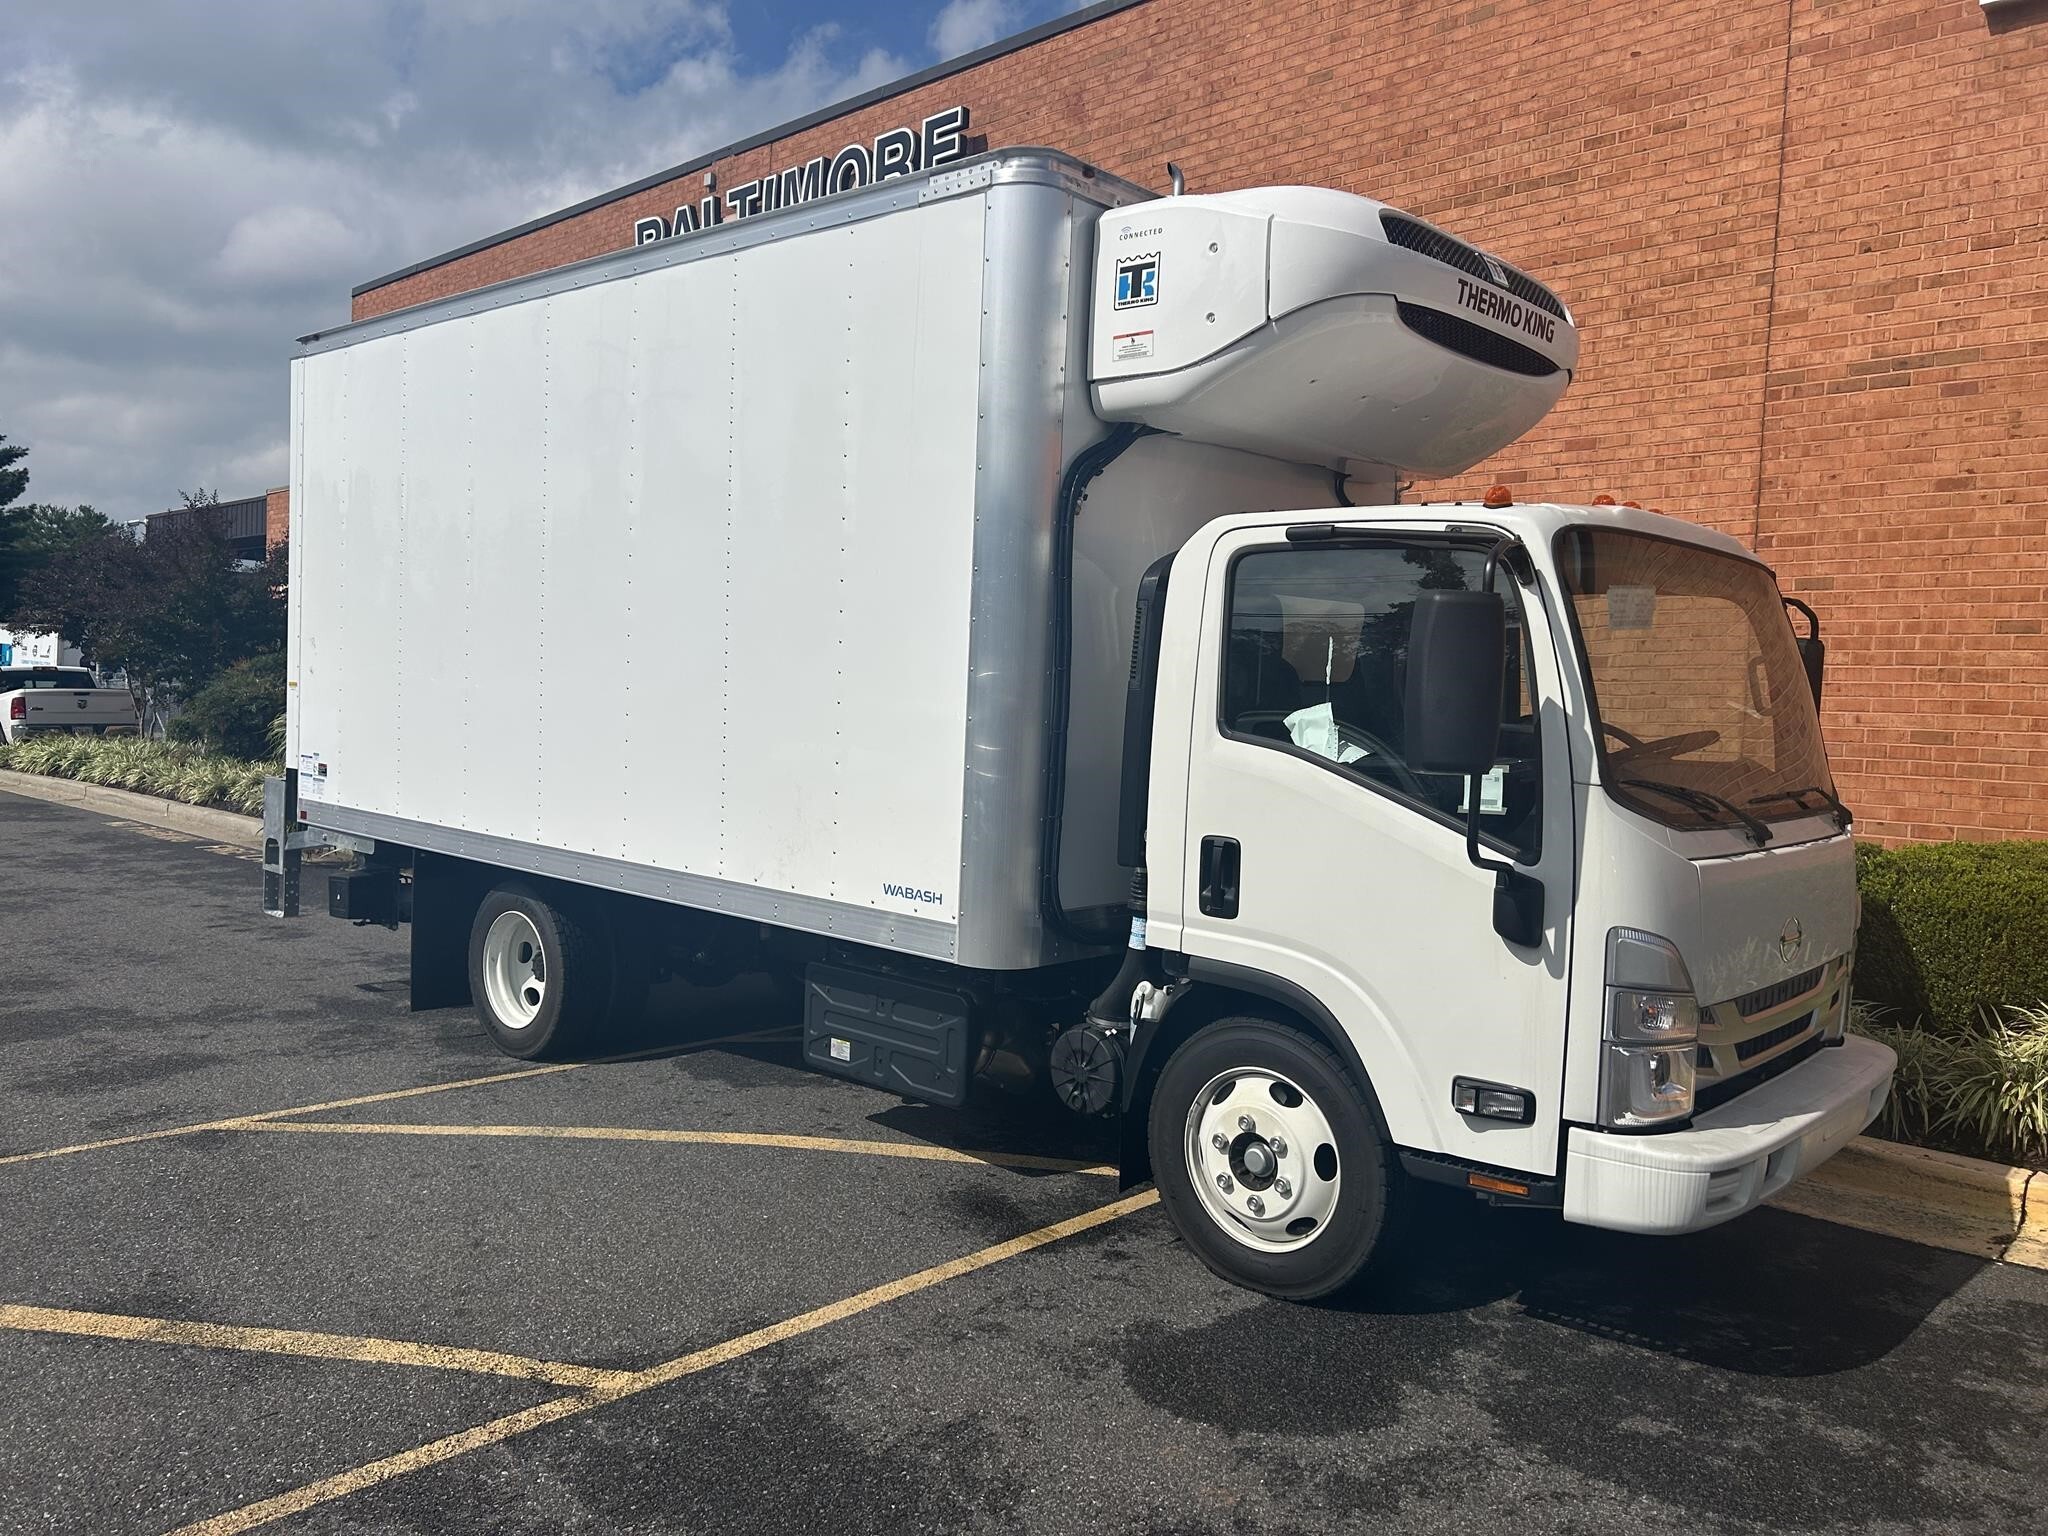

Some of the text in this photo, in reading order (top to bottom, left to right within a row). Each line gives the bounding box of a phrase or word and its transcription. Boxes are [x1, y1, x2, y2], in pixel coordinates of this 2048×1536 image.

[1119, 227, 1163, 241] CONNECTED
[1117, 296, 1154, 307] THERMO KING
[1458, 278, 1555, 343] THERMO KING
[883, 882, 943, 905] WABASH
